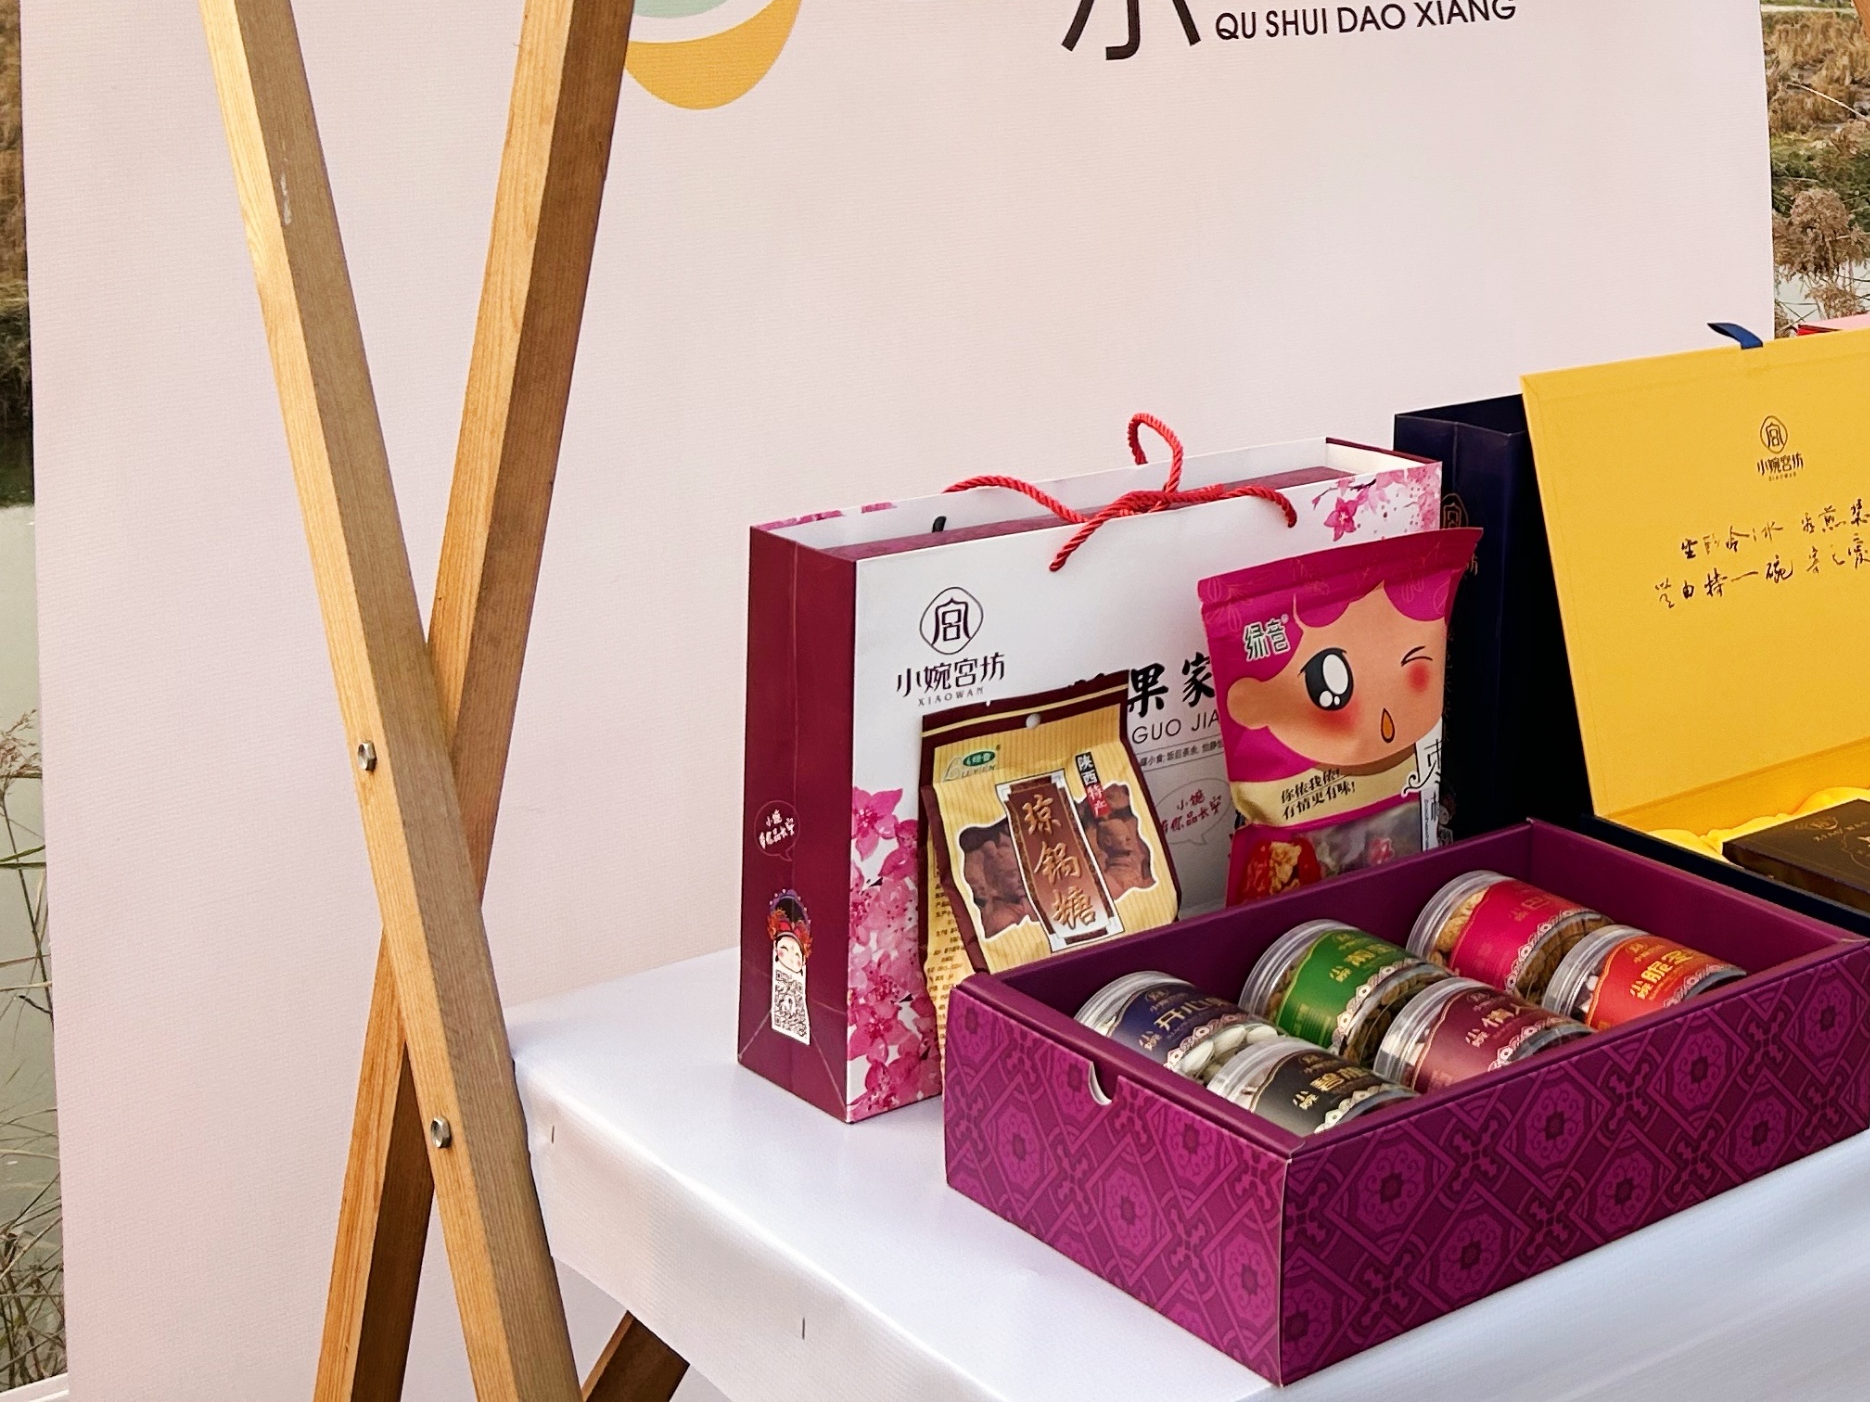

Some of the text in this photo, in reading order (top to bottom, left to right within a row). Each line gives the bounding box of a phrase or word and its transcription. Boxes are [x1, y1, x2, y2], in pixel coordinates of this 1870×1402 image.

[1215, 11, 1257, 40] QU
[1265, 8, 1328, 37] SHUI
[1336, 4, 1407, 33] DAO
[918, 686, 983, 707] XIAOWAN
[1132, 718, 1181, 744] GUO
[1077, 754, 1109, 818] 陕西特产
[1022, 794, 1096, 930] 琼锅糖
